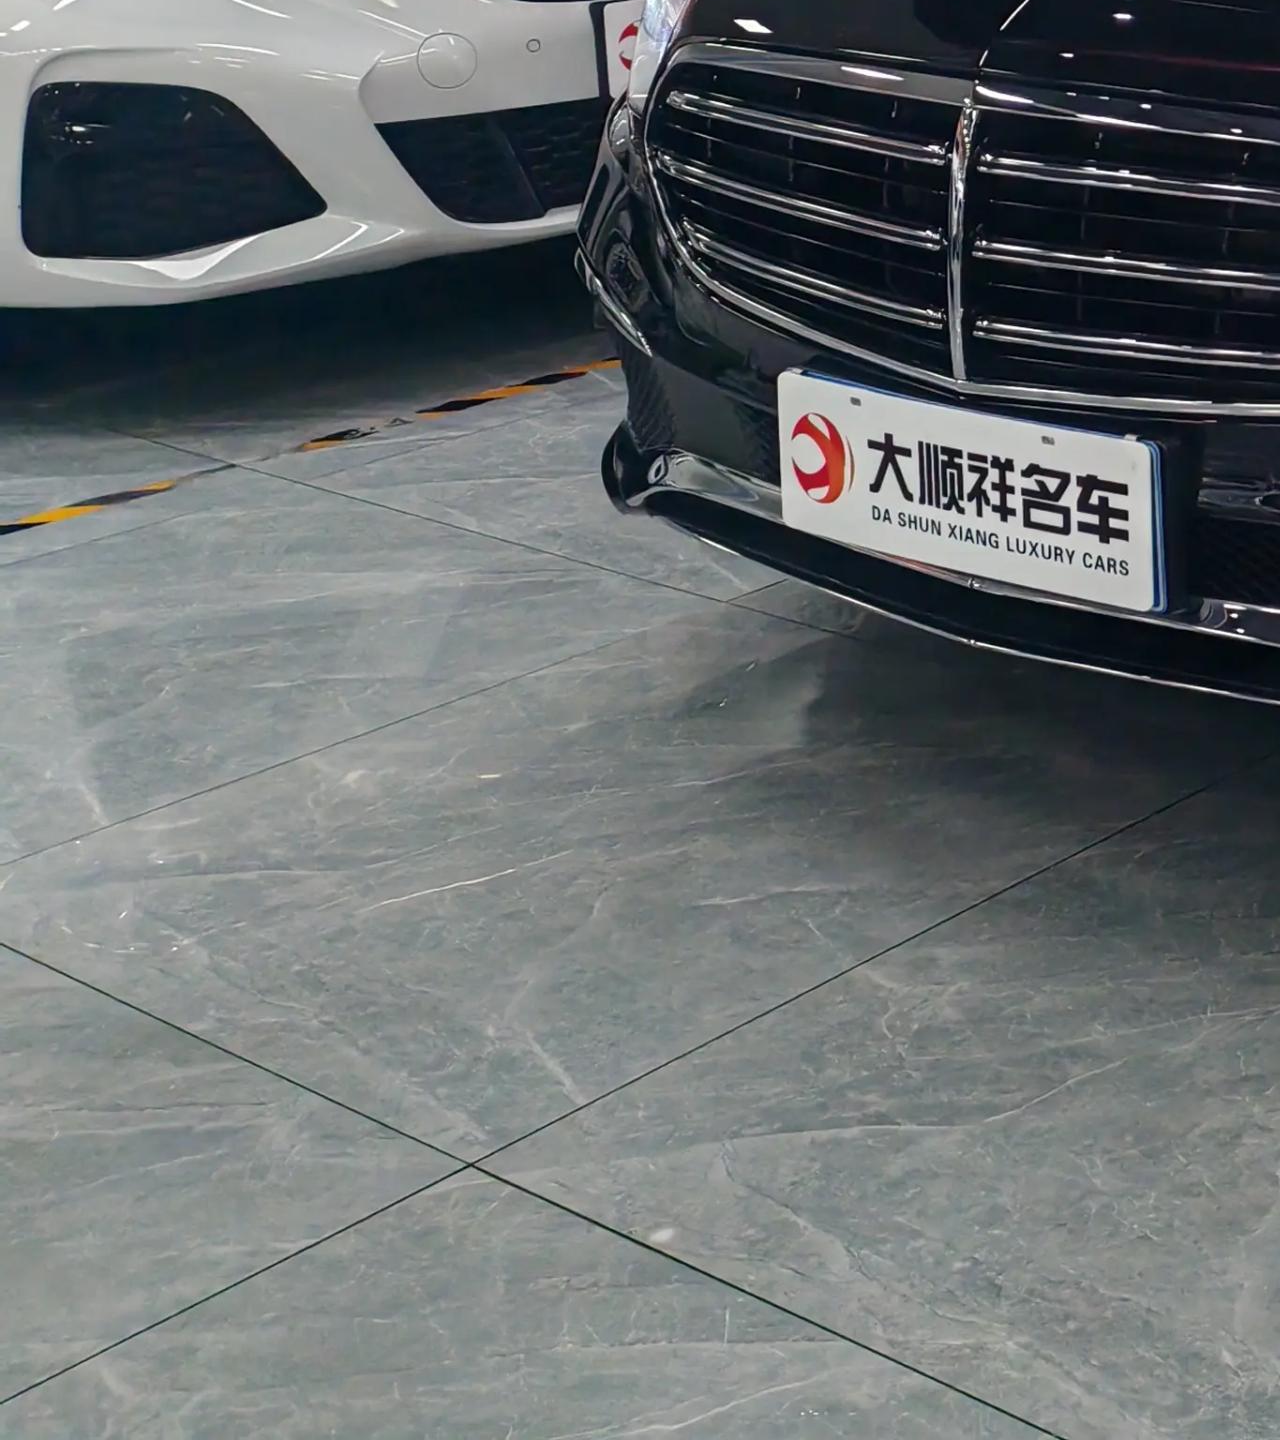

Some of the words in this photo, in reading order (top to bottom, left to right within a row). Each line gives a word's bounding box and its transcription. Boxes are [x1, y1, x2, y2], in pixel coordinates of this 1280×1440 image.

[867, 432, 1130, 544] 大顺祥名车
[872, 505, 892, 525] DA
[898, 512, 941, 536] SHUN
[948, 524, 1000, 549] XIANG
[1006, 536, 1075, 565] LUXURY
[1083, 553, 1130, 576] CARS
